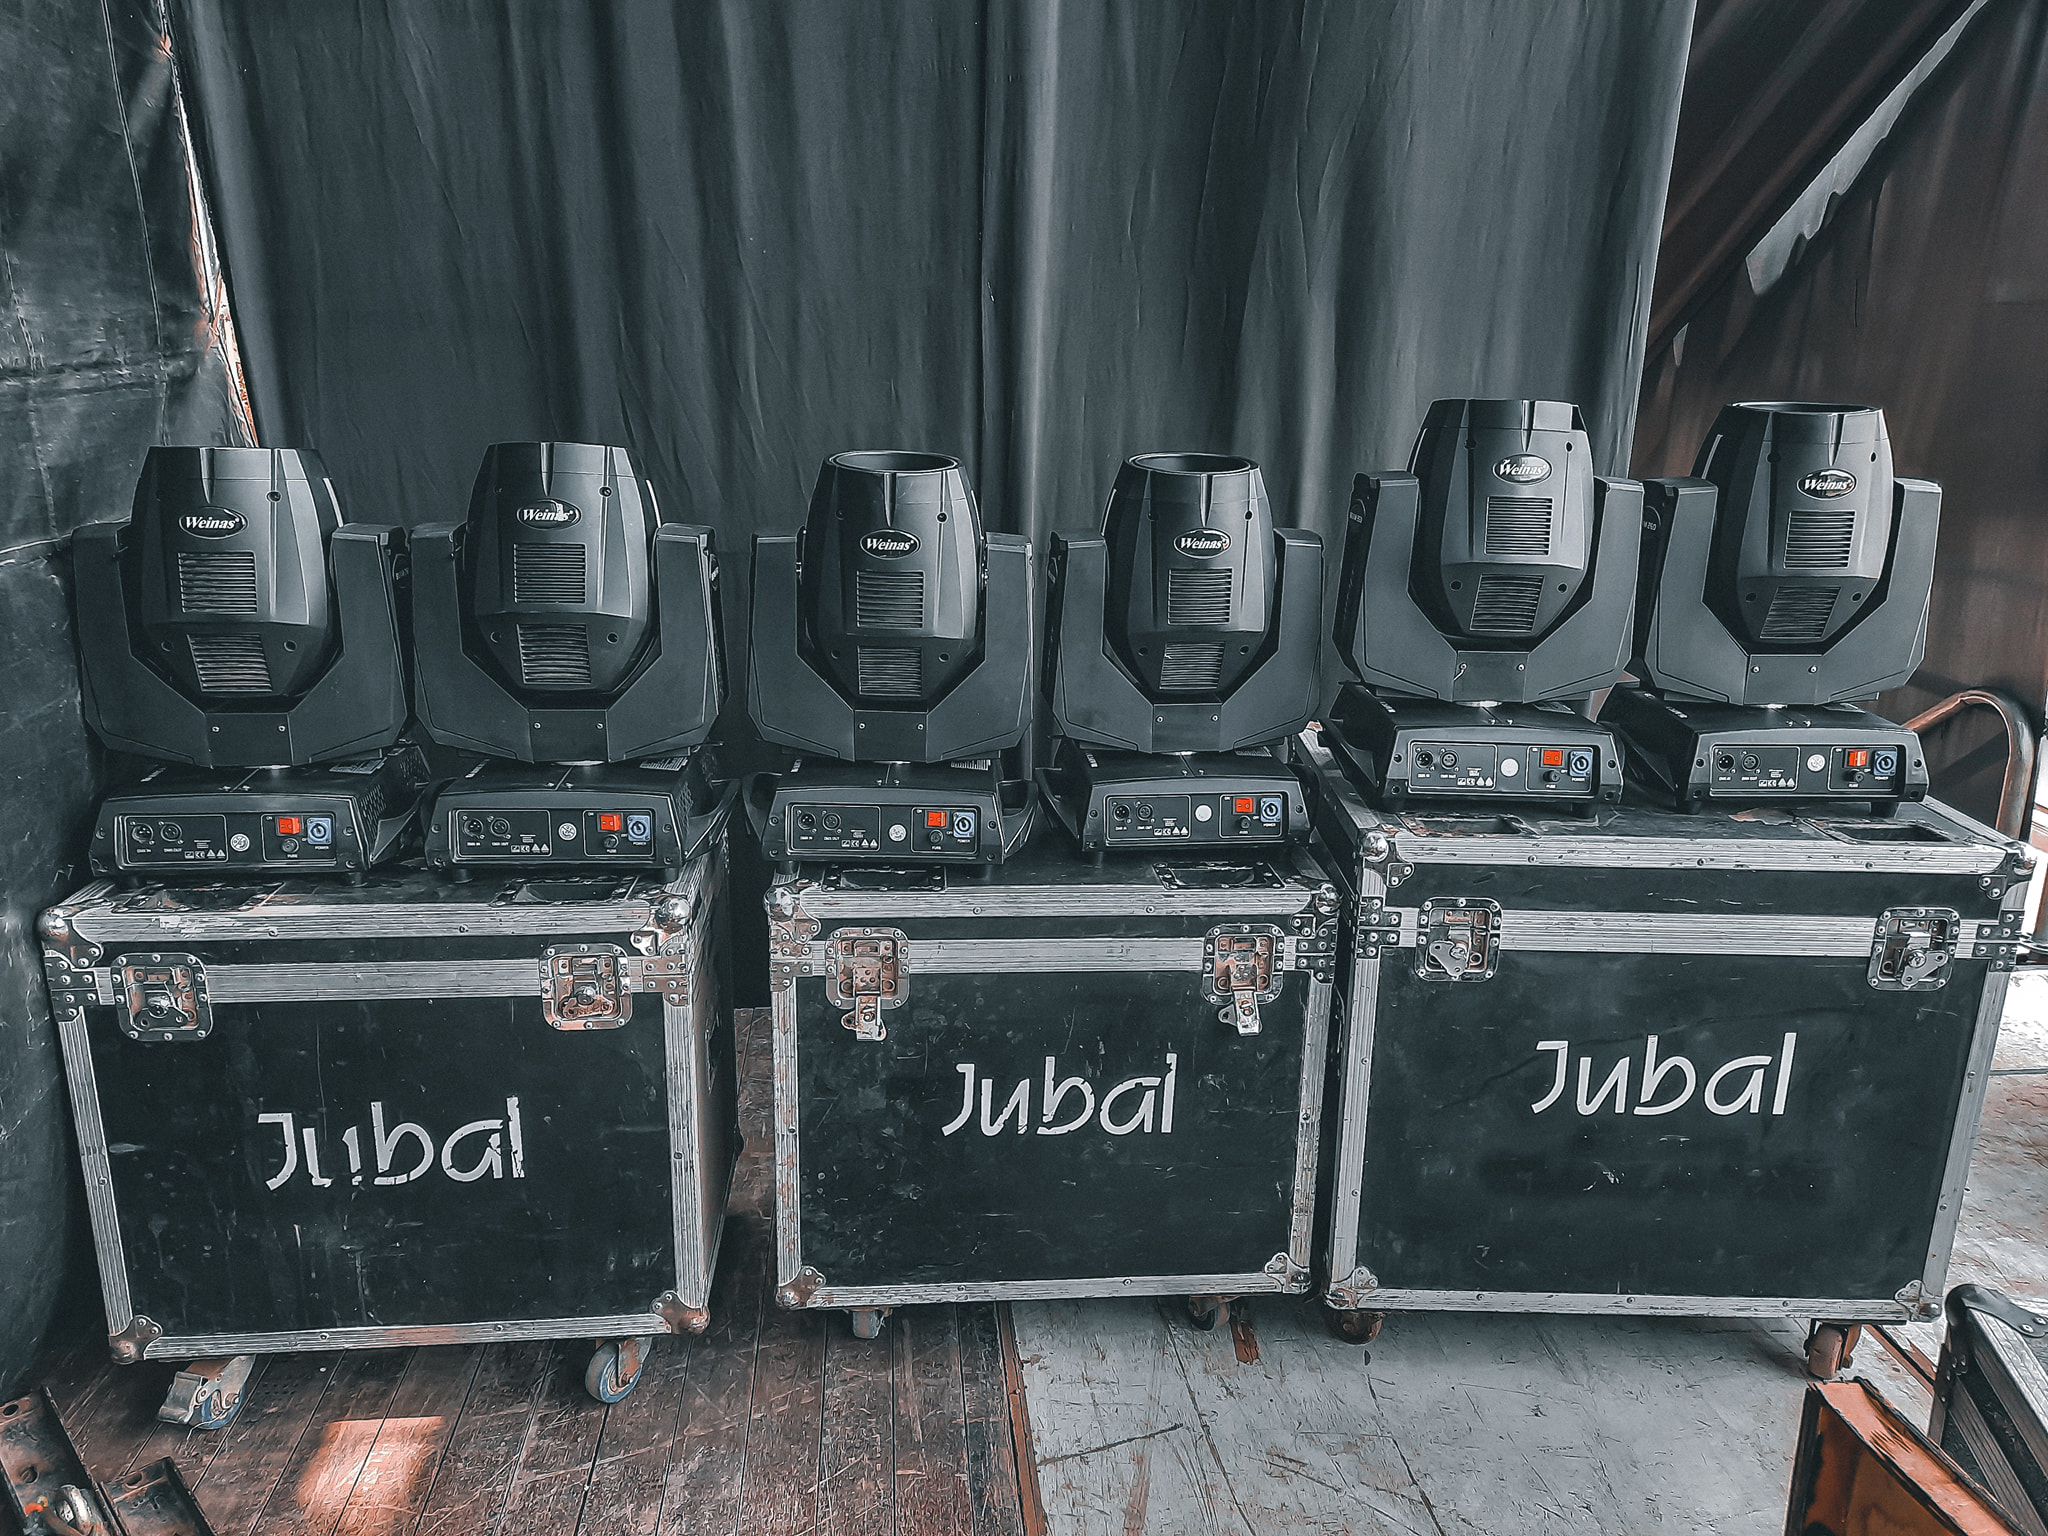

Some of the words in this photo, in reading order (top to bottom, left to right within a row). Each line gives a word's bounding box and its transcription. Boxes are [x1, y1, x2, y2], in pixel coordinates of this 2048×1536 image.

[1499, 463, 1543, 476] Weinas
[1804, 479, 1847, 490] Weinas
[186, 516, 236, 530] Weinas
[866, 538, 911, 552] Weinas
[1180, 537, 1222, 550] Weinas
[1532, 1033, 1796, 1115] Jubal
[942, 1053, 1177, 1136] Jubal
[258, 1096, 524, 1190] Jubal
